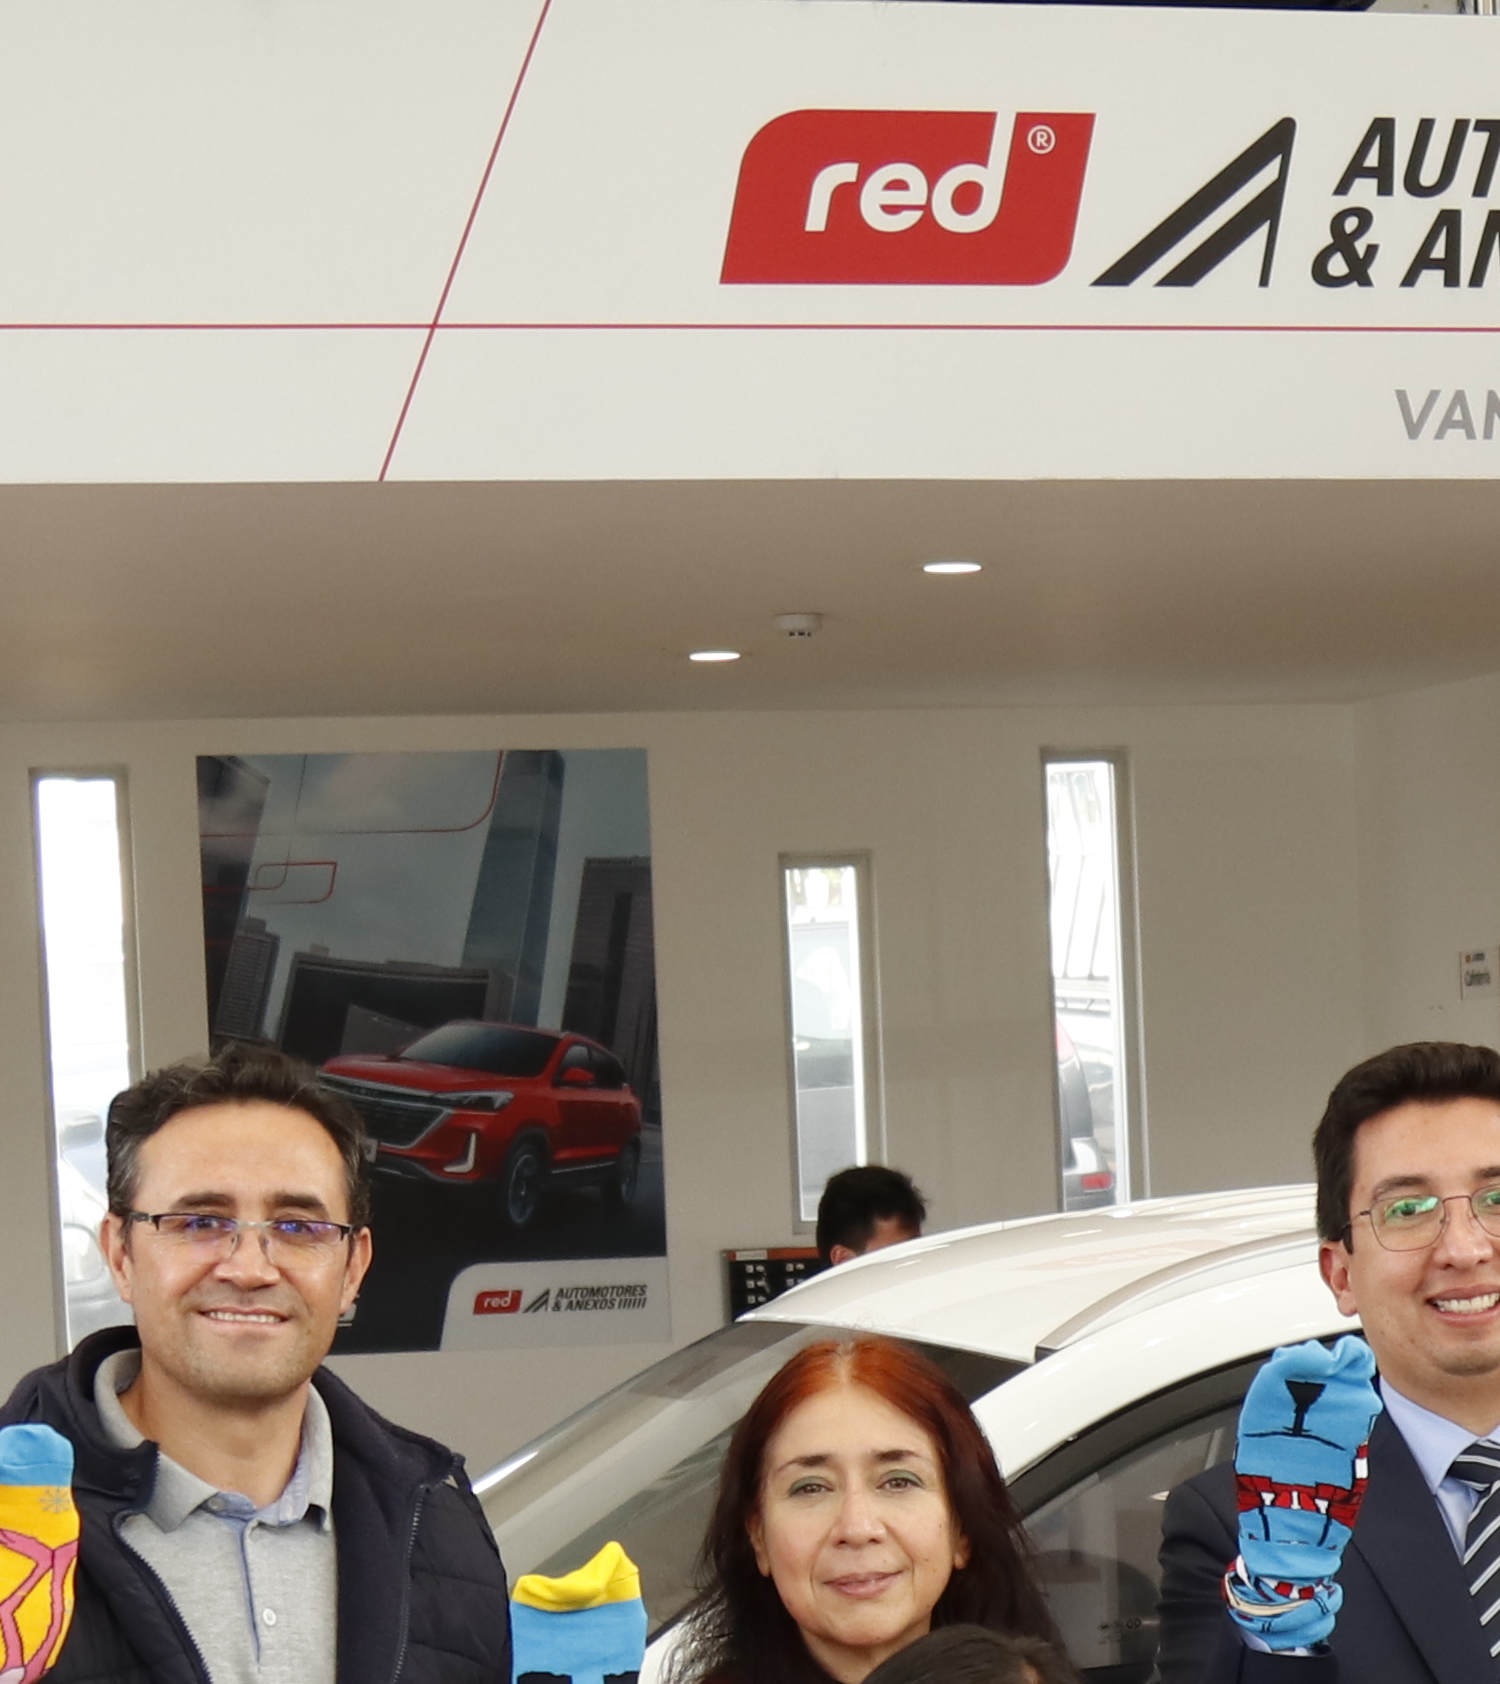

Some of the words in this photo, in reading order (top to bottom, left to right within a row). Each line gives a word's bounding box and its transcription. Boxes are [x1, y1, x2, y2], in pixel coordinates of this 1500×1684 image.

[1310, 208, 1376, 290] &
[556, 1284, 647, 1299] AUTOMOTORES
[565, 1298, 617, 1312] ANEXOS
